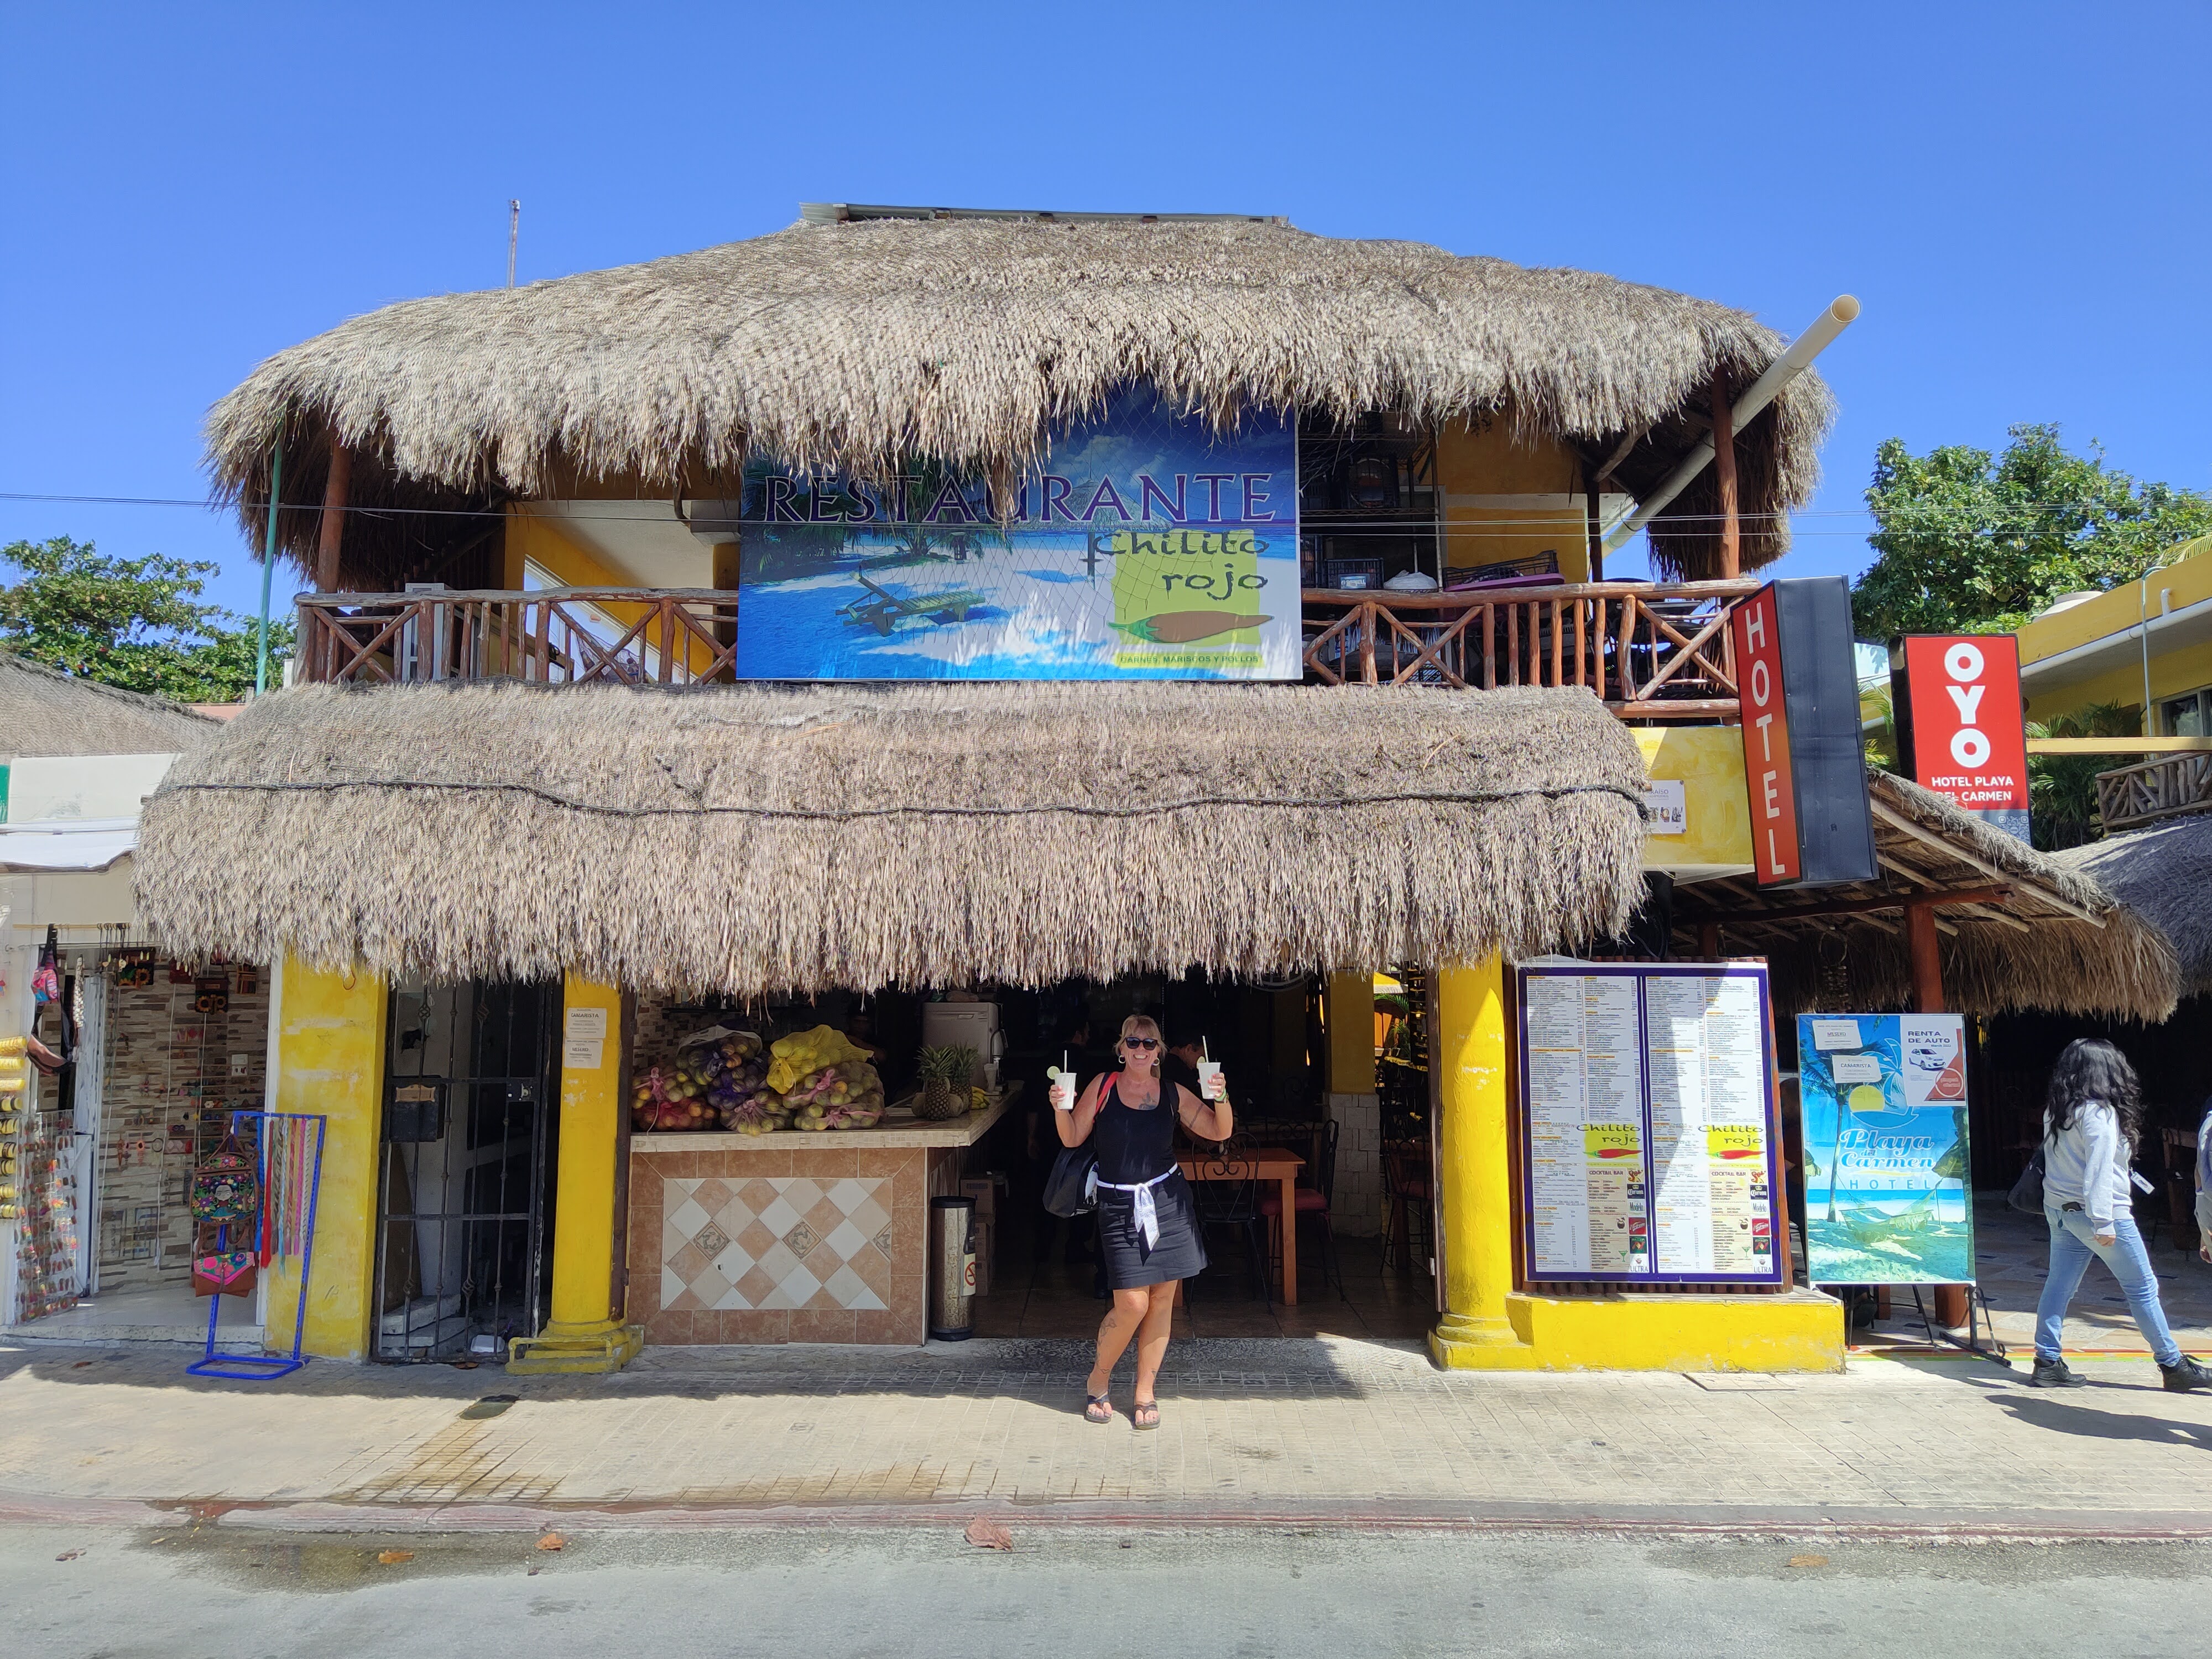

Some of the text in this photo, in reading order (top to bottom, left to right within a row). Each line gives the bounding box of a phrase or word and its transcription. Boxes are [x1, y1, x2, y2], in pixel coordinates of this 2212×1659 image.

[764, 473, 1276, 523] RESTAURANTE
[1161, 563, 1269, 601] rojo
[1944, 643, 1991, 768] OYO
[1745, 602, 1786, 875] HOTEL
[1931, 776, 2014, 786] HOTEL PLAYA
[1961, 791, 2012, 801] CARMEN
[1576, 1123, 1641, 1131] Chilito
[1698, 1124, 1764, 1133] Chilito
[1601, 1134, 1641, 1146] rojo
[1724, 1135, 1764, 1147] rojo
[1839, 1128, 1935, 1157] Playa
[1840, 1151, 1936, 1168] Carmen
[1850, 1179, 1931, 1190] HOTEL
